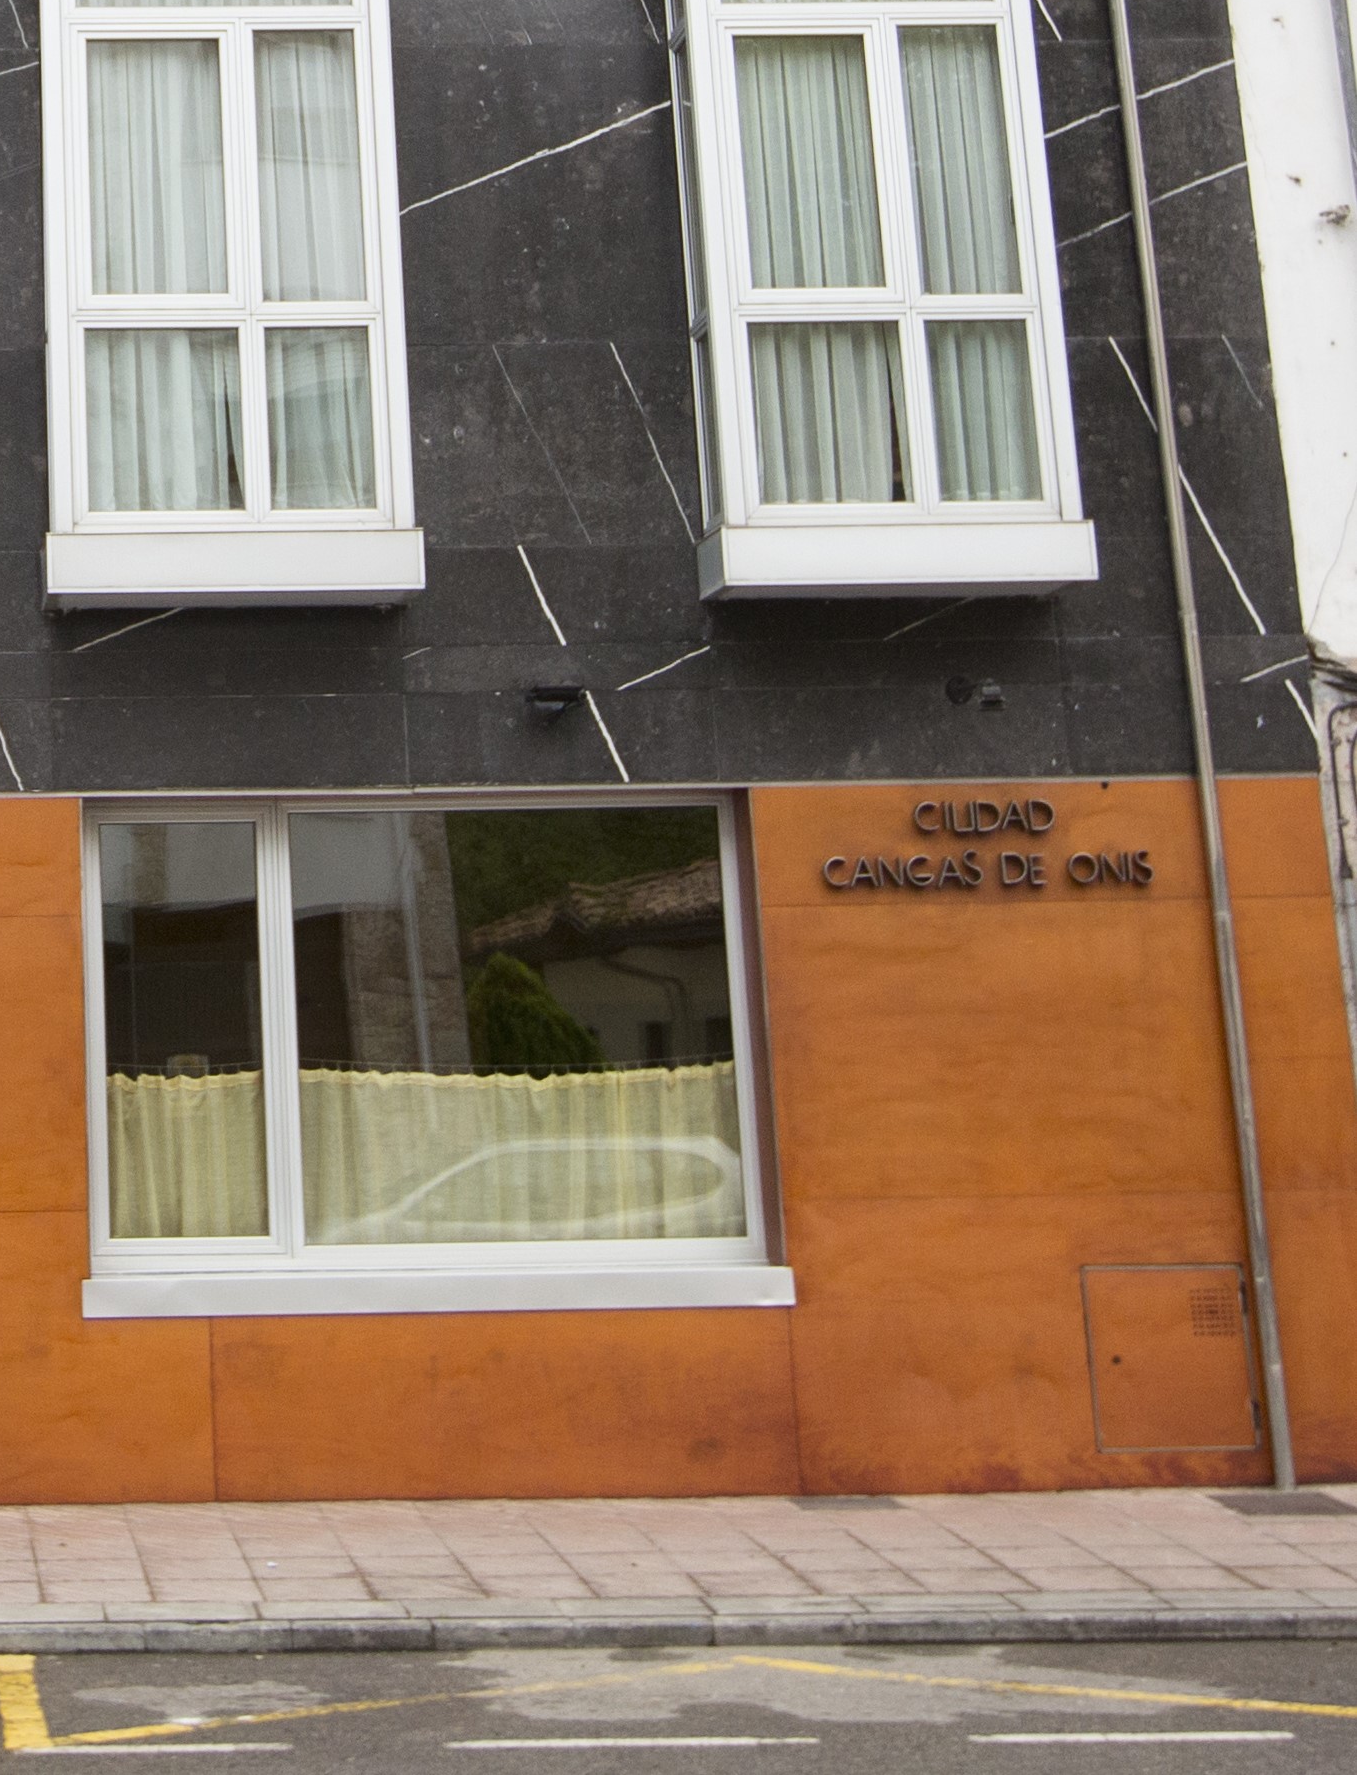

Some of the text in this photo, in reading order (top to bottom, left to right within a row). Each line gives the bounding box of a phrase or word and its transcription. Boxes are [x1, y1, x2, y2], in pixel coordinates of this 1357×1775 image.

[913, 799, 1056, 833] CIUDAD
[823, 848, 1155, 888] CANGAS DE ONIS
